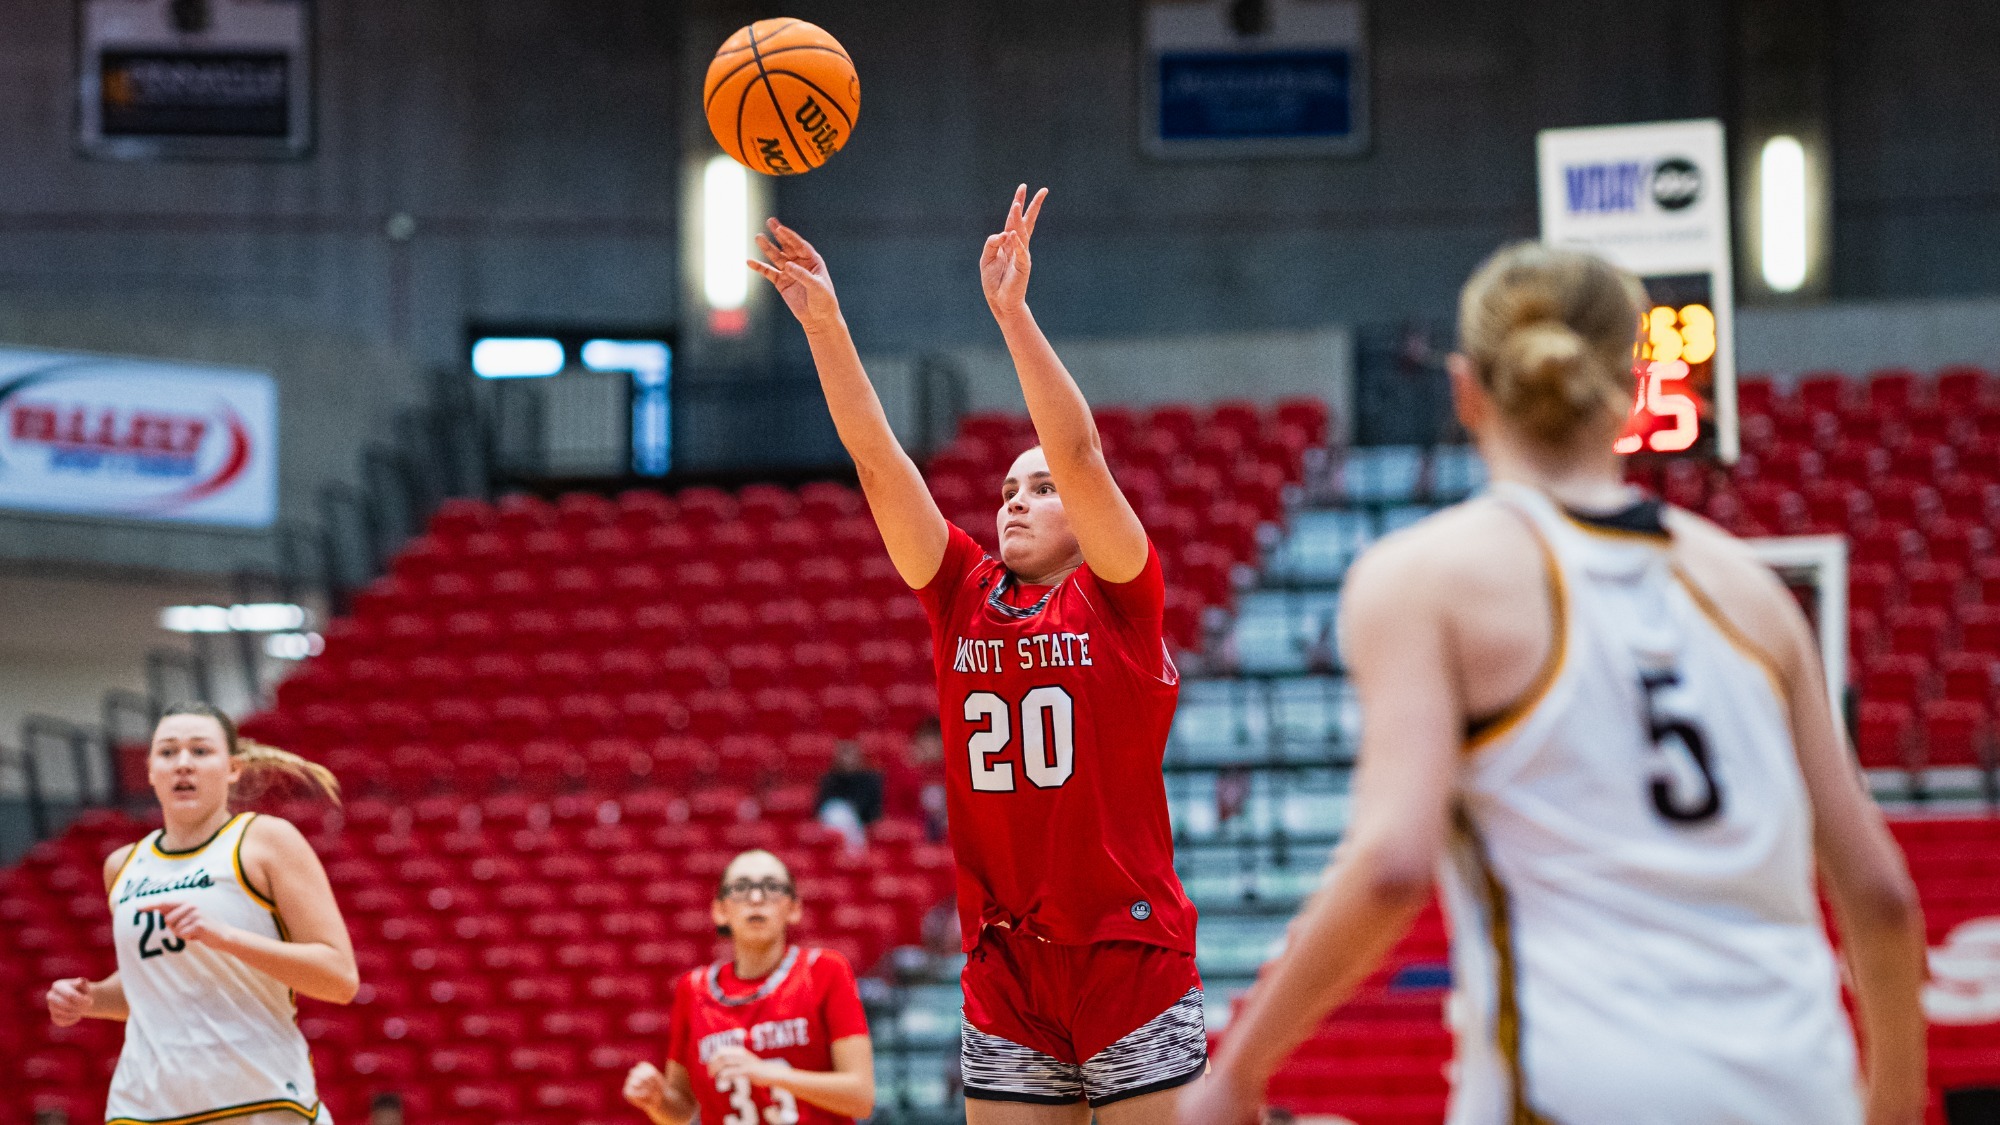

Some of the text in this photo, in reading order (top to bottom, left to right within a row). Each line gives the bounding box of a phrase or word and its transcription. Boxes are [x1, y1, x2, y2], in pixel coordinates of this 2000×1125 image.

[1017, 633, 1093, 670] STATE
[963, 684, 1075, 793] 20
[1638, 668, 1726, 824] 5
[751, 1018, 809, 1051] STATE
